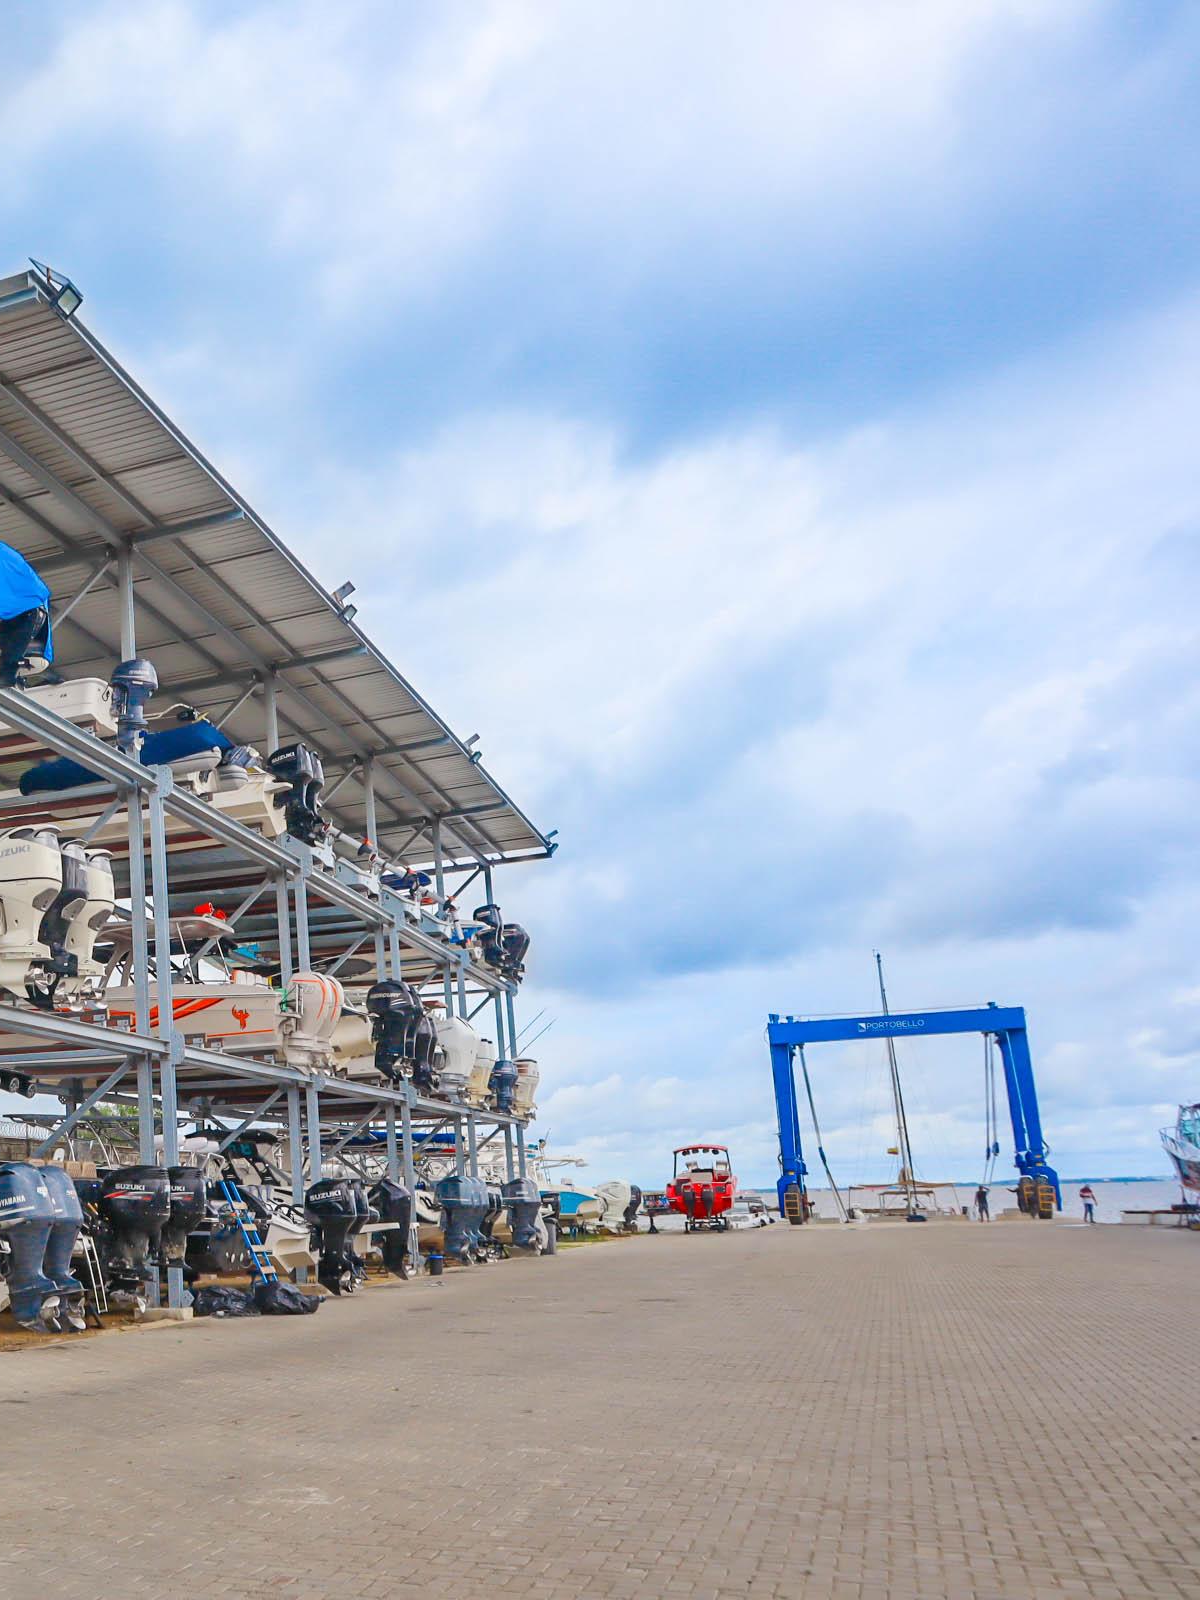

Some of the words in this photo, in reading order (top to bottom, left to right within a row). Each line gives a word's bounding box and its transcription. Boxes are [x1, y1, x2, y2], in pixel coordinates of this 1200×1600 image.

[866, 1019, 925, 1030] PORTOBELLO
[115, 1183, 145, 1191] SUZUKI
[1, 1194, 26, 1207] YAMAHA
[309, 1189, 341, 1201] SUZUKI
